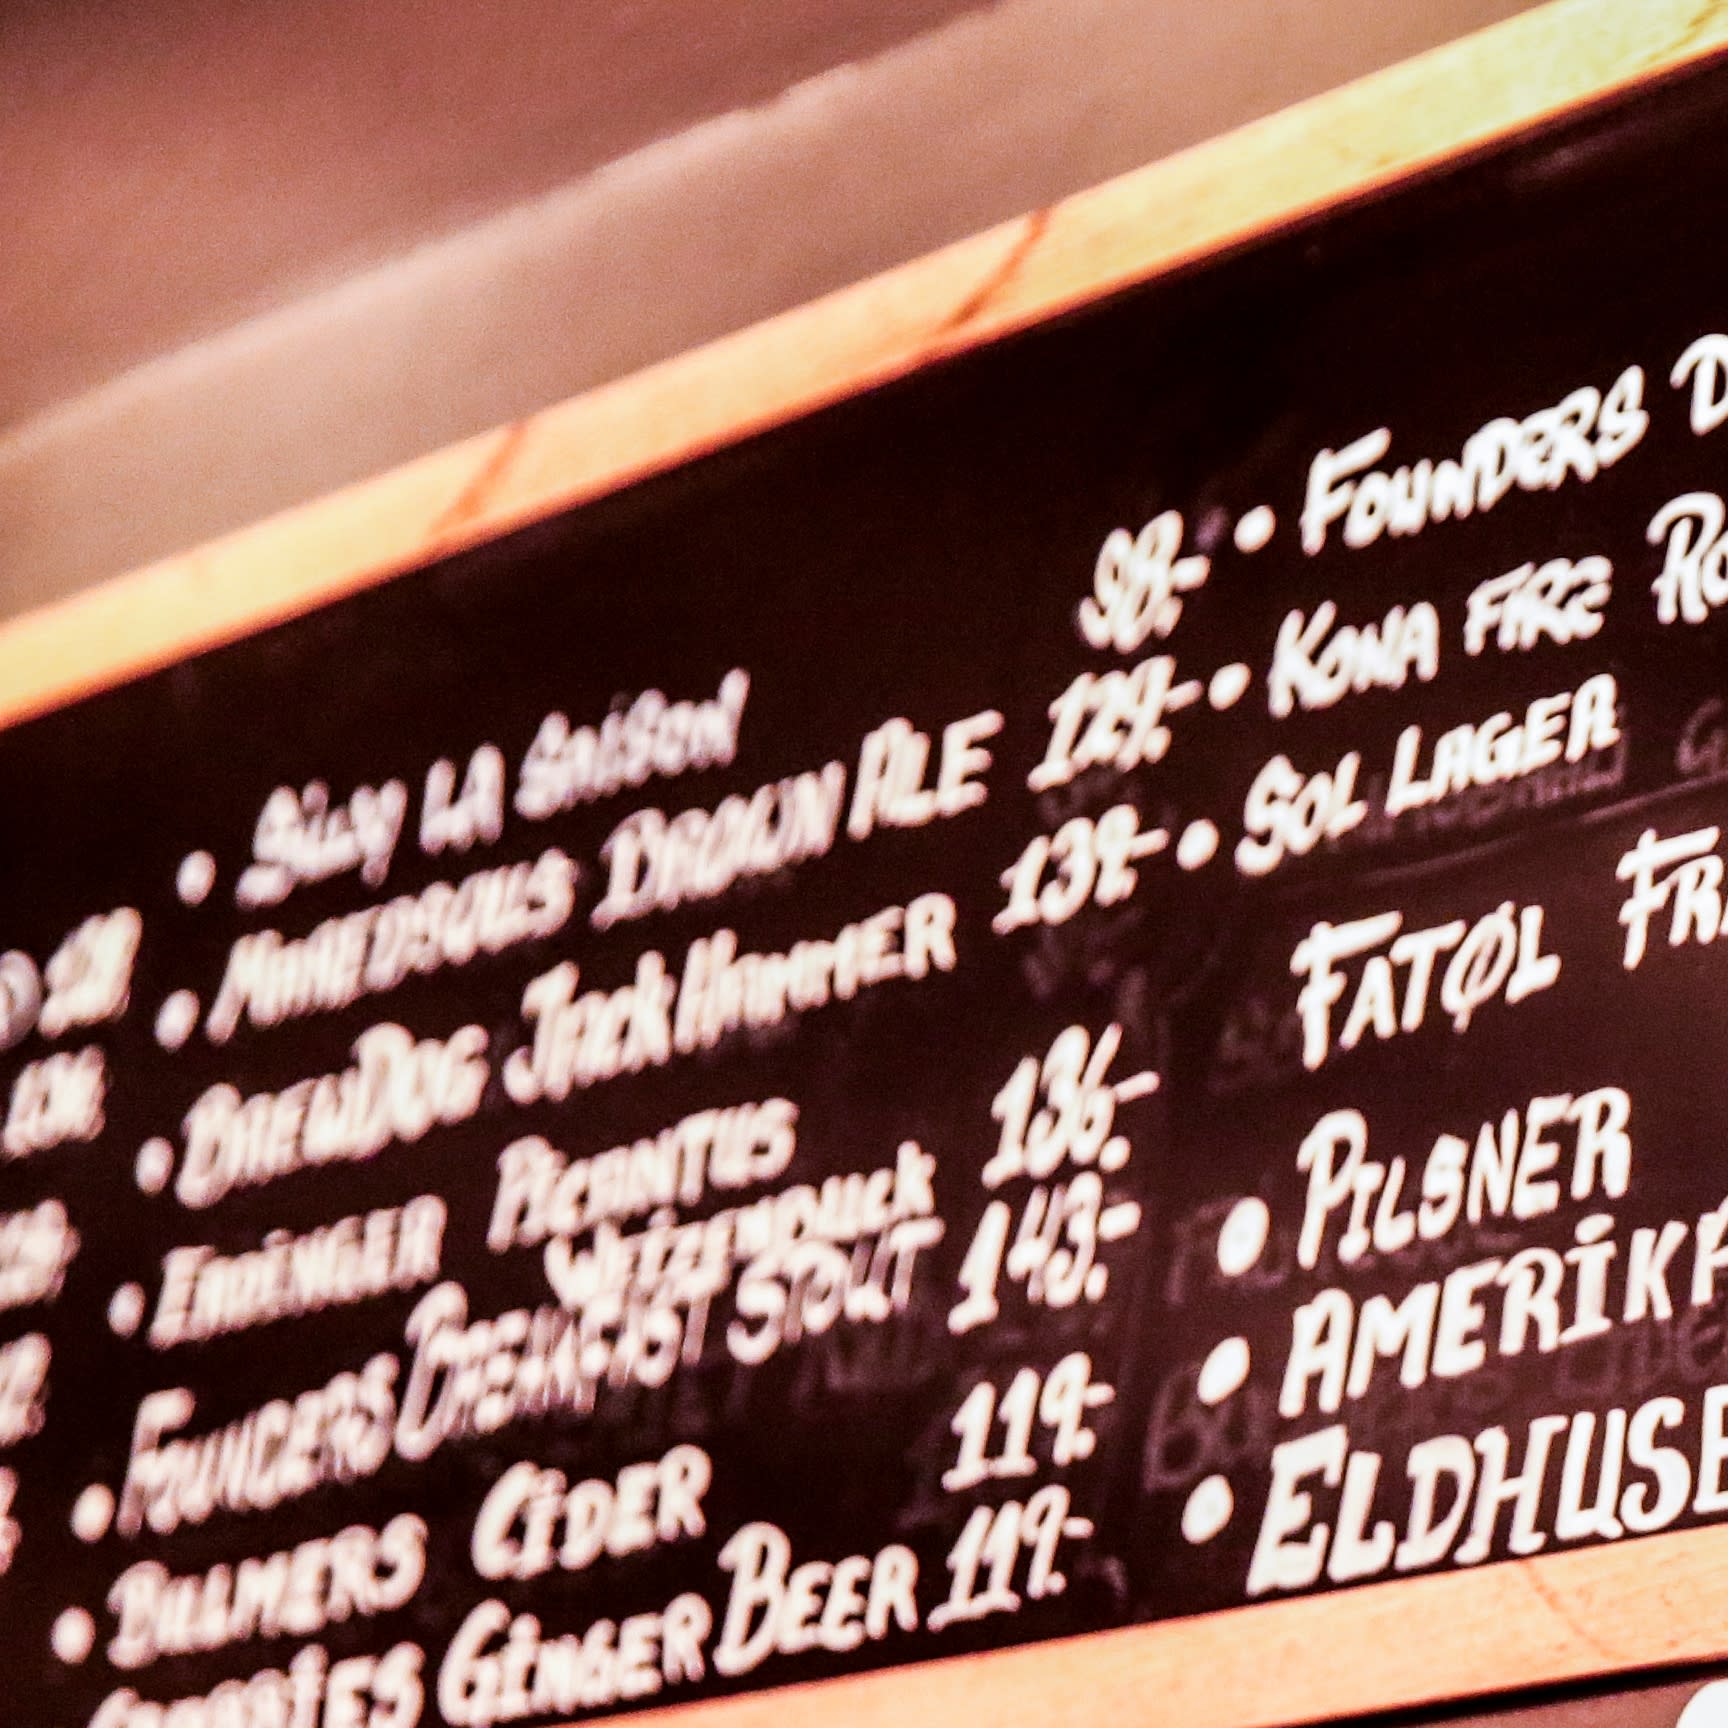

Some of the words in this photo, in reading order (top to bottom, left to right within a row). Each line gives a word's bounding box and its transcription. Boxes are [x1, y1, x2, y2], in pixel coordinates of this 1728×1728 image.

[1301, 364, 1650, 556] FOUNDERS
[1267, 600, 1439, 719] KONA
[1234, 752, 1368, 877] SOL
[1384, 671, 1621, 819] LAGER
[1288, 899, 1562, 1072] FATØL
[1296, 1085, 1632, 1272] PILSNER
[470, 1445, 713, 1582] CIDER
[712, 1520, 921, 1677] BEER
